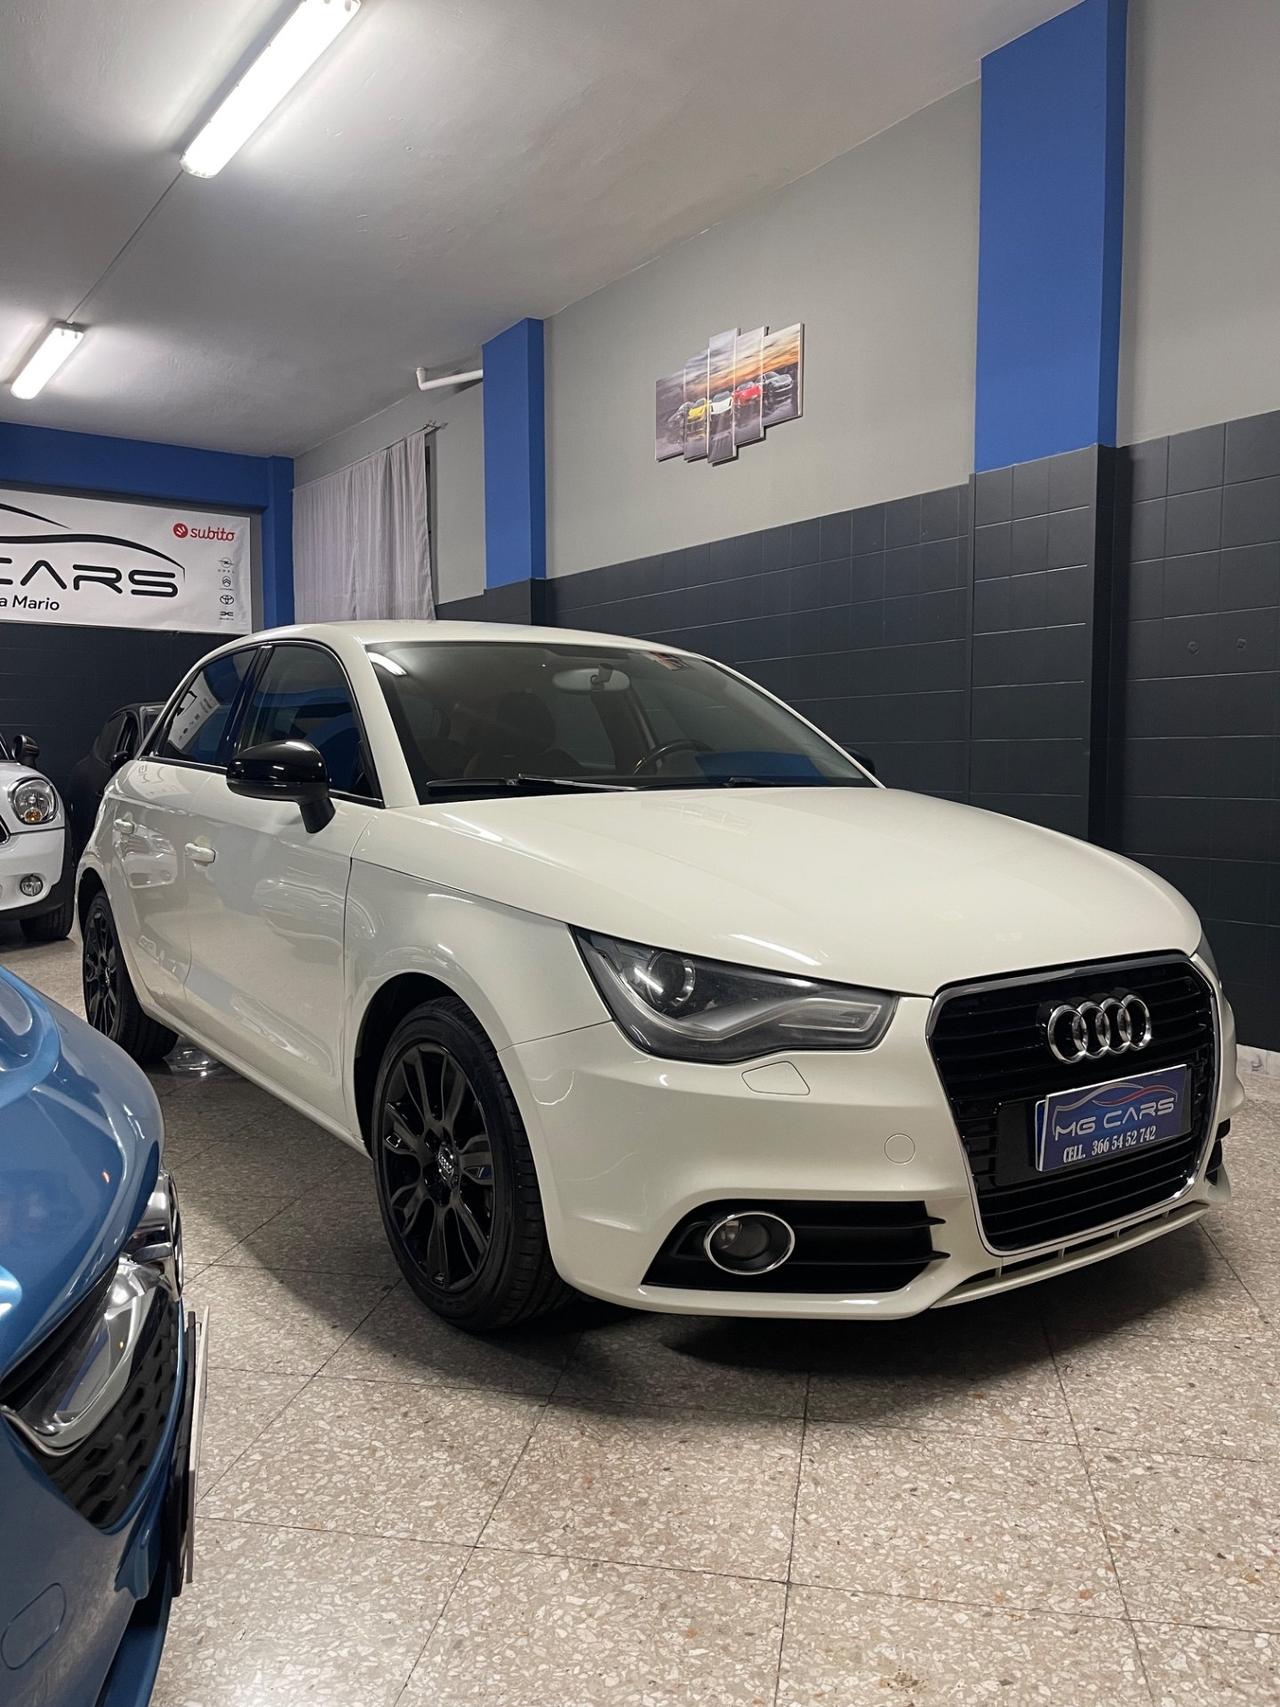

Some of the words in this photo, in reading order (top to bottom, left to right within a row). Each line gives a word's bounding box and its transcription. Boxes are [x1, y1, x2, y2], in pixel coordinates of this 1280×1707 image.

[190, 526, 235, 542] subito
[0, 557, 179, 598] ARS
[12, 594, 60, 611] Mario
[1055, 1116, 1096, 1141] MG
[1104, 1098, 1175, 1129] CARS
[1063, 1145, 1086, 1164] CELL.
[1092, 1137, 1110, 1156] 366
[1111, 1133, 1124, 1150] 54
[1125, 1130, 1137, 1146] 52
[1139, 1126, 1156, 1143] 742
